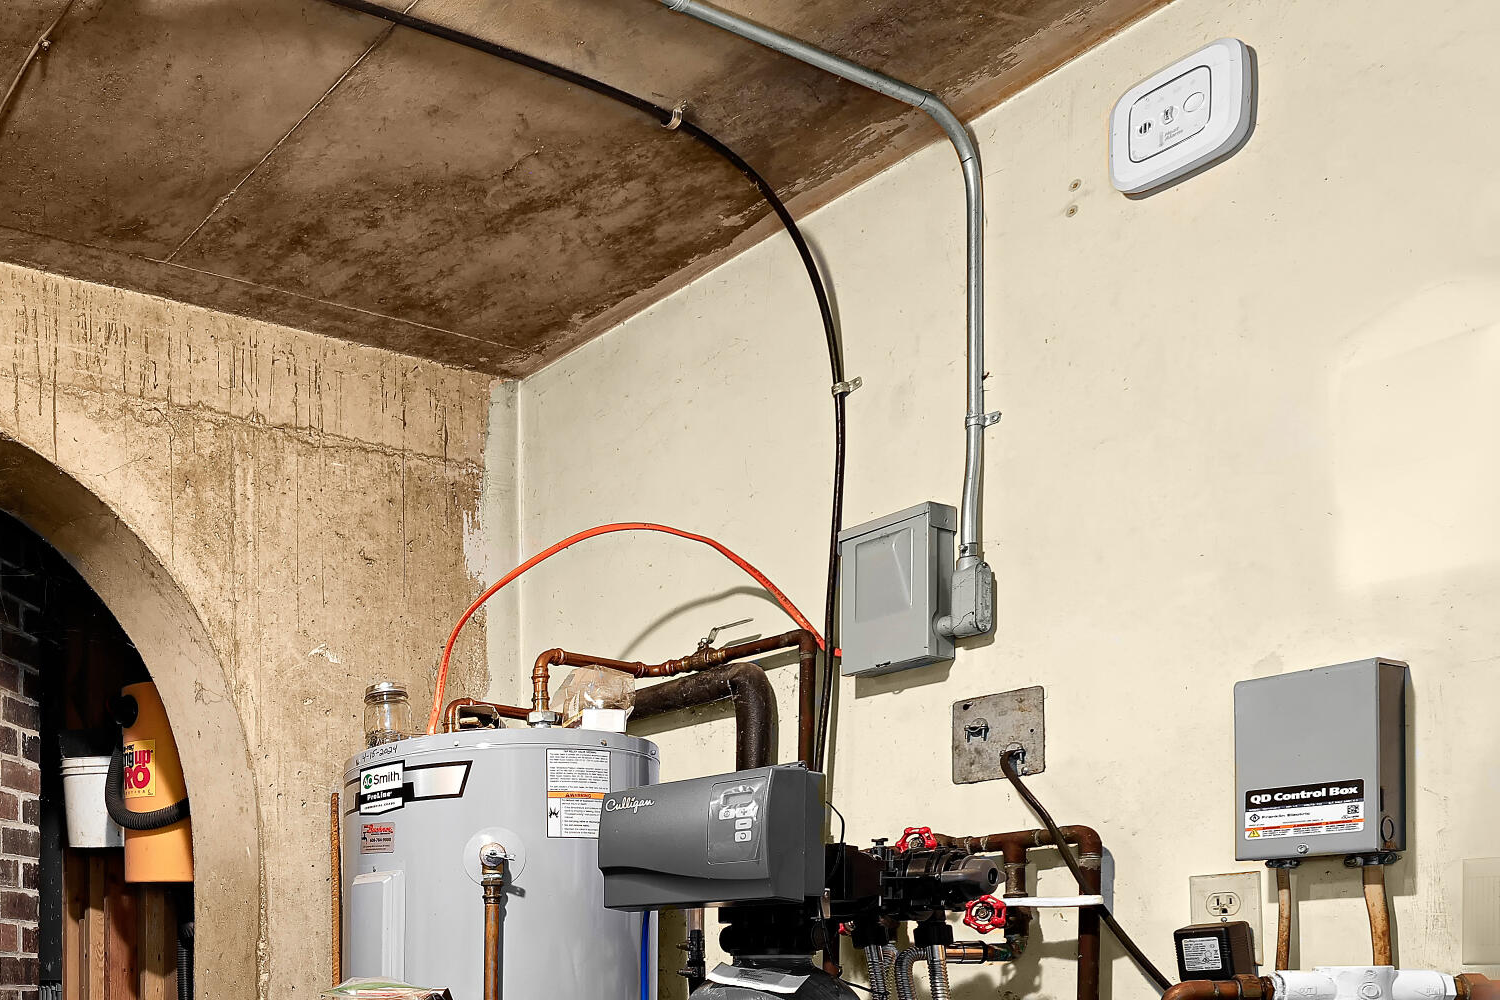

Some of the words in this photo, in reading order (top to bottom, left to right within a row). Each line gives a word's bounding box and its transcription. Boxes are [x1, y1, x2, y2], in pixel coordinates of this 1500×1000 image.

[373, 771, 400, 785] Smith
[1250, 794, 1272, 805] QD
[1273, 787, 1327, 801] Control
[1329, 786, 1359, 796] Box
[605, 797, 655, 814] Culligan
